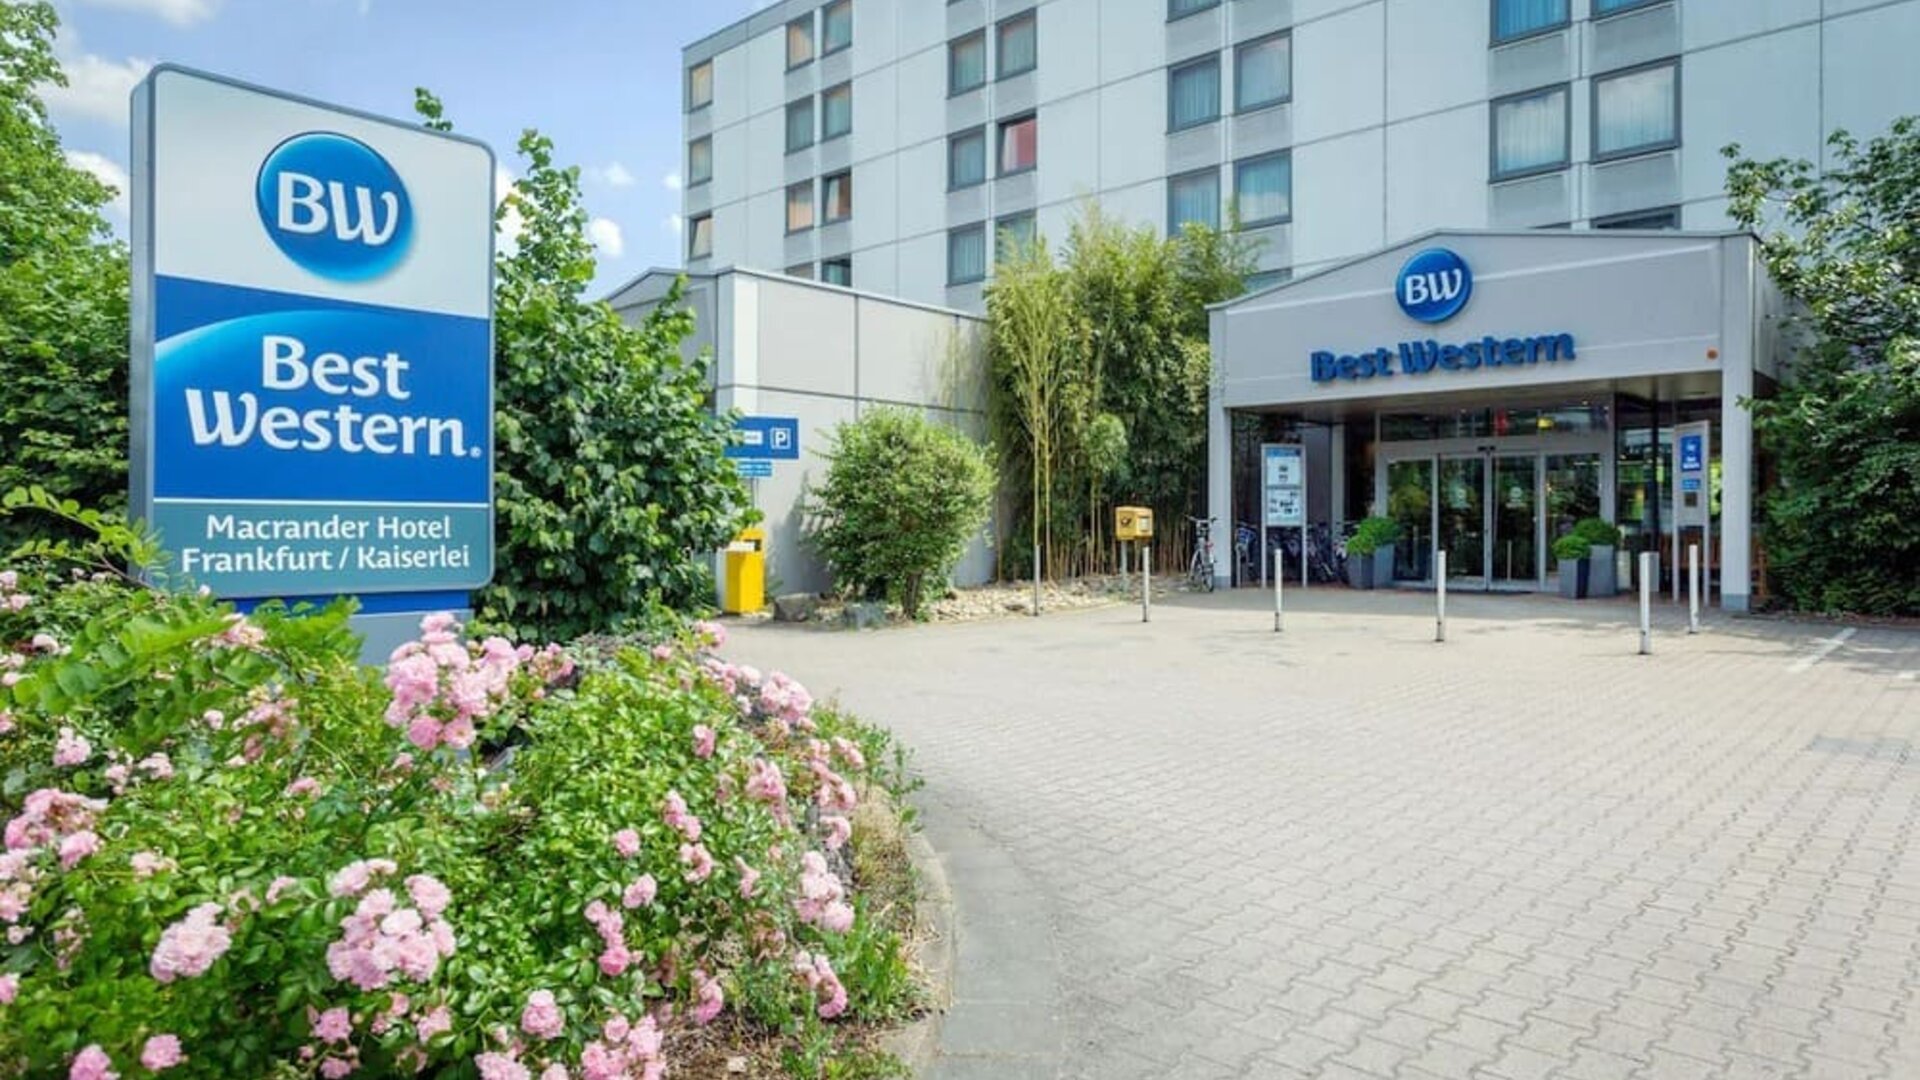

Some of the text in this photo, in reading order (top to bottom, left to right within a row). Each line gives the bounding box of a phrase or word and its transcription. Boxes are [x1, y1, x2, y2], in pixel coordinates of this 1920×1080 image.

[277, 171, 399, 246] BW
[1405, 268, 1463, 306] BW
[262, 335, 411, 400] Best
[1310, 332, 1576, 383] Best Western
[774, 431, 787, 447] P
[206, 514, 451, 540] Macrander Hotel
[182, 545, 470, 573] Frankfurt / Kaiserlei
